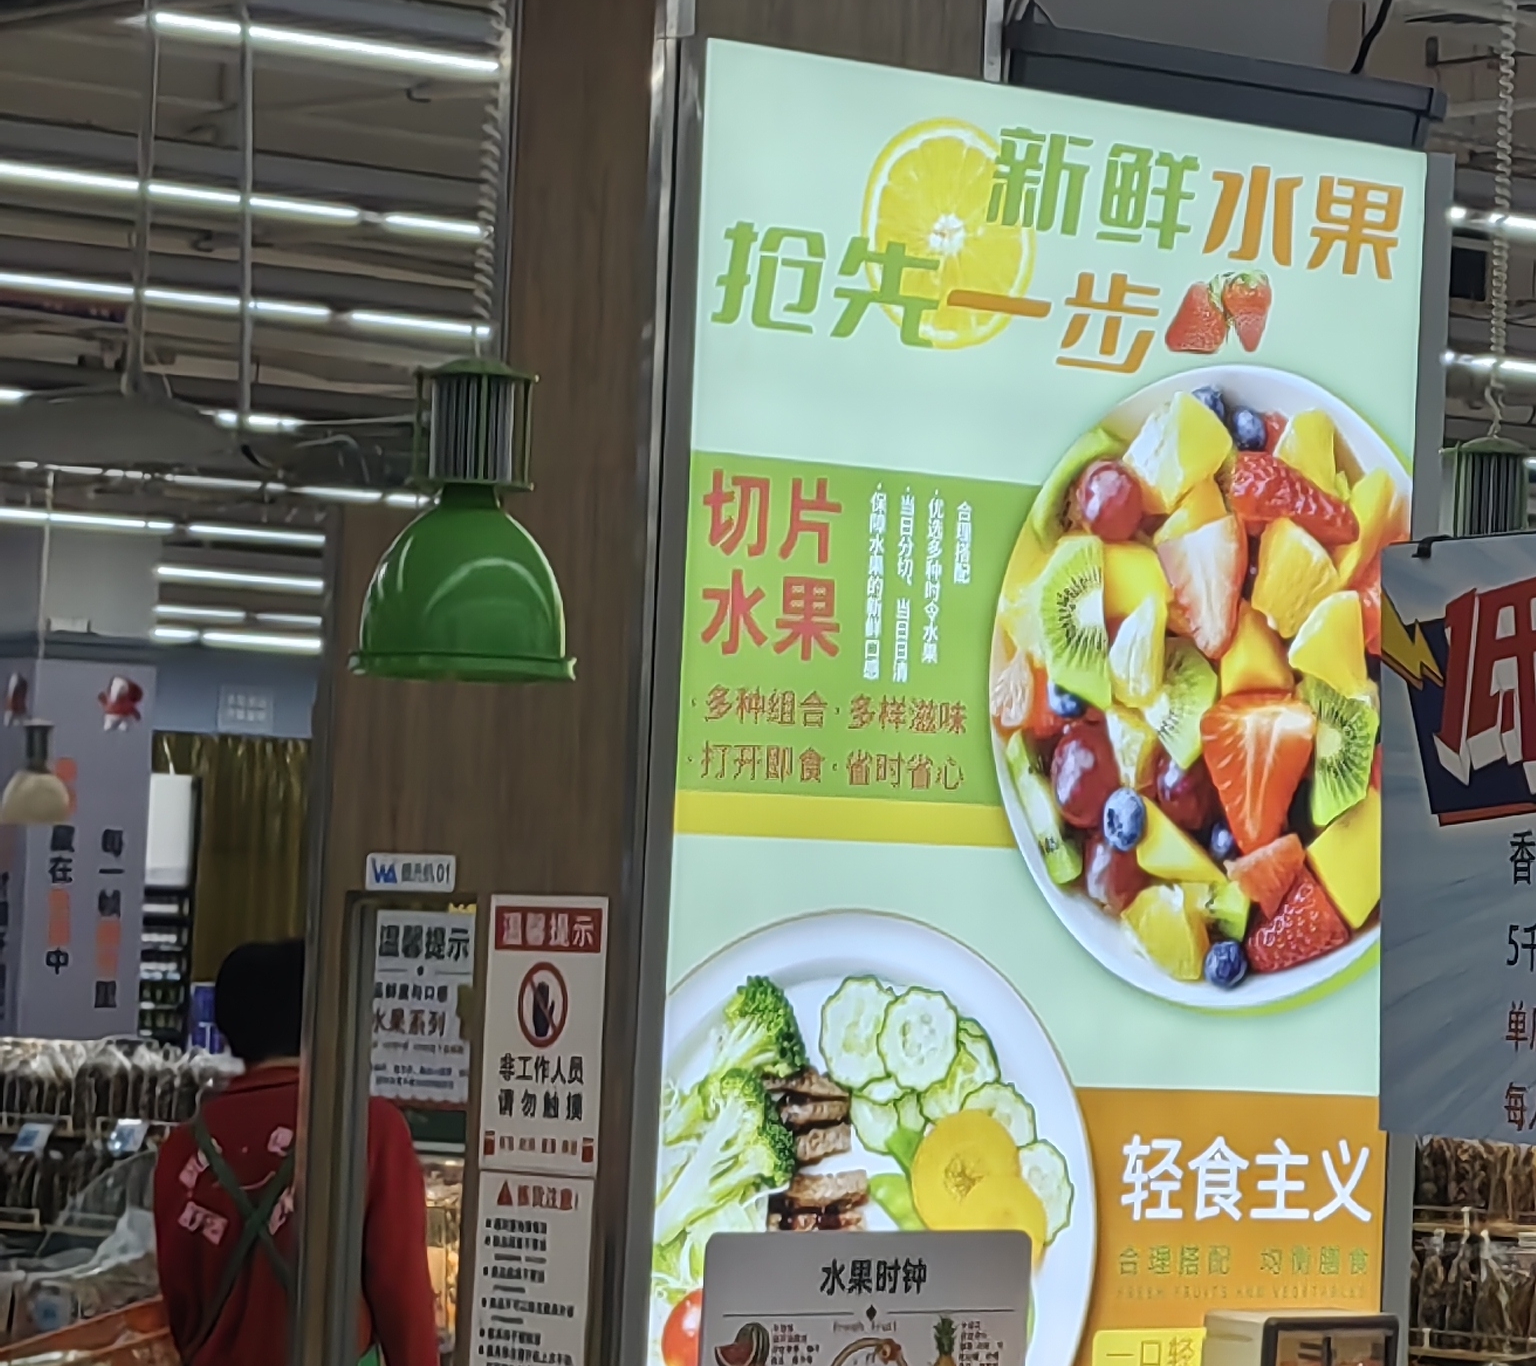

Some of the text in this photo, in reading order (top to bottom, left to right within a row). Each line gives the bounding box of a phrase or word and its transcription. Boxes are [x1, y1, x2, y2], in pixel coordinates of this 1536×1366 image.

[986, 125, 1405, 281] 新鲜水果
[710, 220, 1162, 375] 抢先一步
[702, 469, 843, 564] 切片
[700, 568, 841, 662] 水果
[703, 684, 968, 735] 多种组合 多样滋味
[701, 740, 965, 791] 打开即食 省时省心
[499, 1052, 585, 1086] 非工作人员
[1120, 1133, 1372, 1223] 轻食主义
[819, 1257, 928, 1296] 水果时钟
